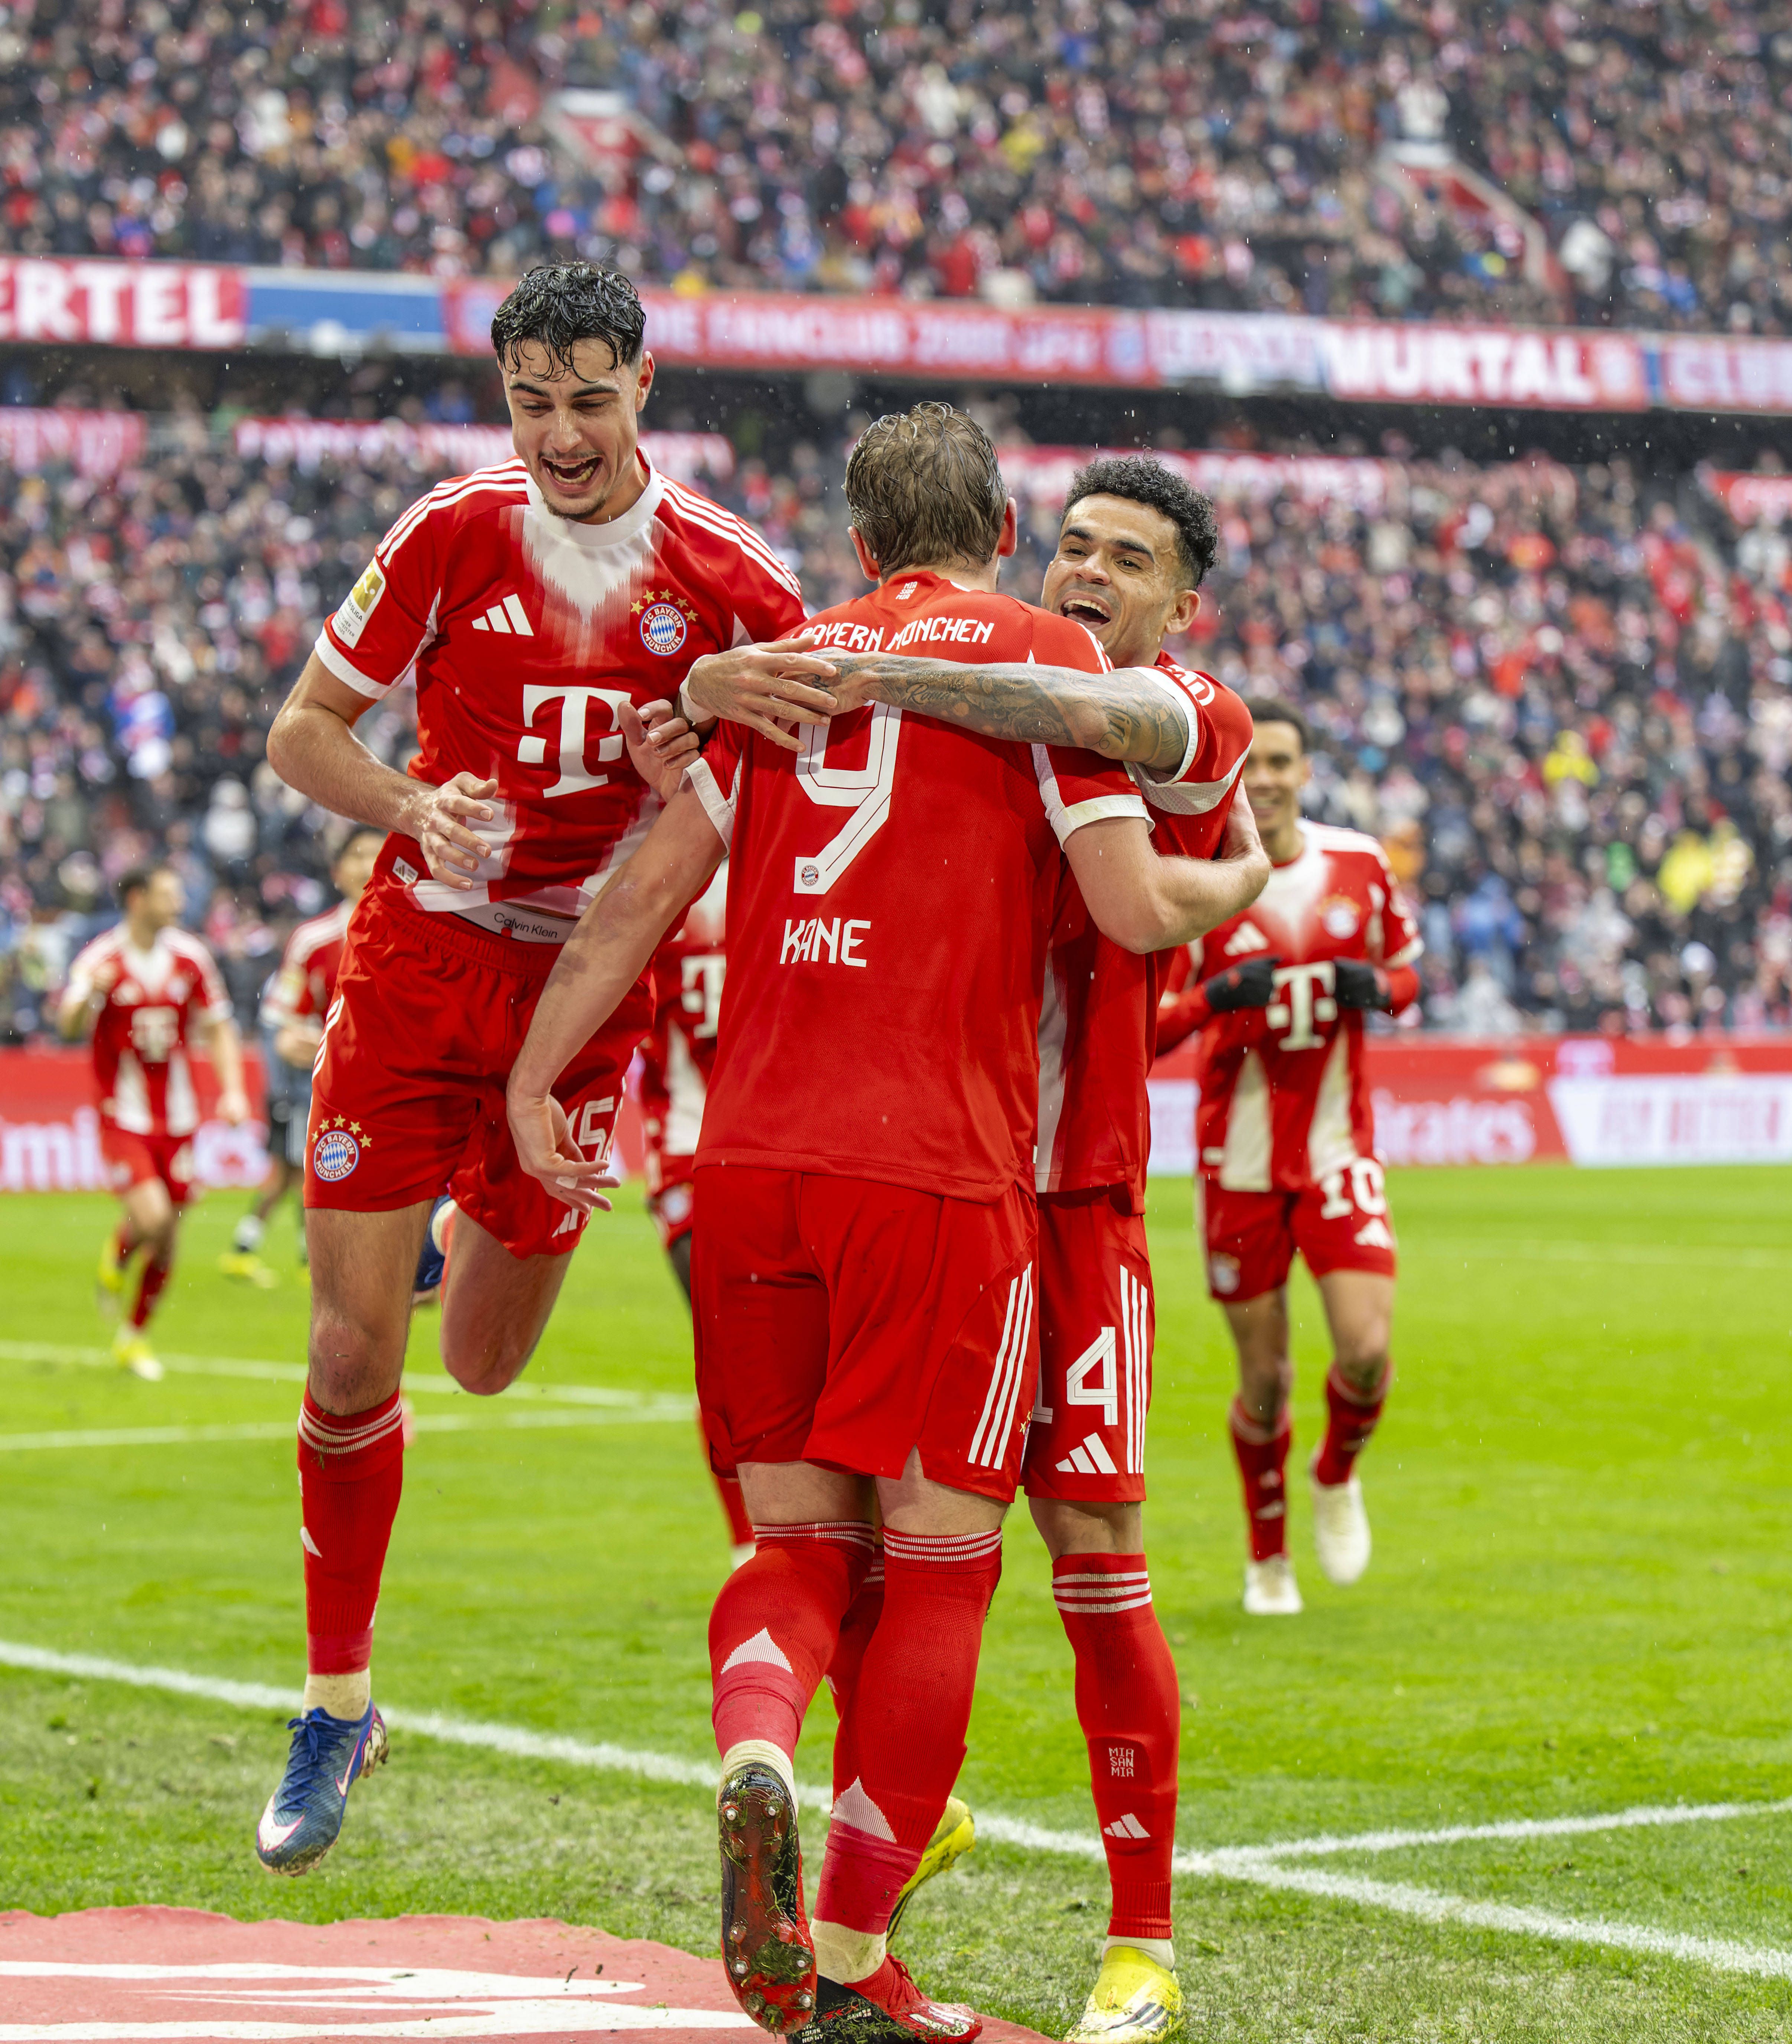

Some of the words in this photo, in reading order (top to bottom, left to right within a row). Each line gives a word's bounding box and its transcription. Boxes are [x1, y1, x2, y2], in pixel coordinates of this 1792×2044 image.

[348, 596, 362, 621] DESLIGA
[644, 613, 654, 625] FC
[654, 607, 682, 628] BAYERN
[794, 701, 902, 894] 9
[494, 912, 529, 932] Calvin
[532, 924, 558, 938] Klein
[780, 917, 871, 967] KANE
[318, 1141, 326, 1153] FC
[327, 1135, 355, 1155] BAYERN
[1320, 1156, 1388, 1220] 10
[1108, 1747, 1134, 1757] MIA
[1110, 1757, 1134, 1768] SAN
[1111, 1767, 1134, 1777] MIA
